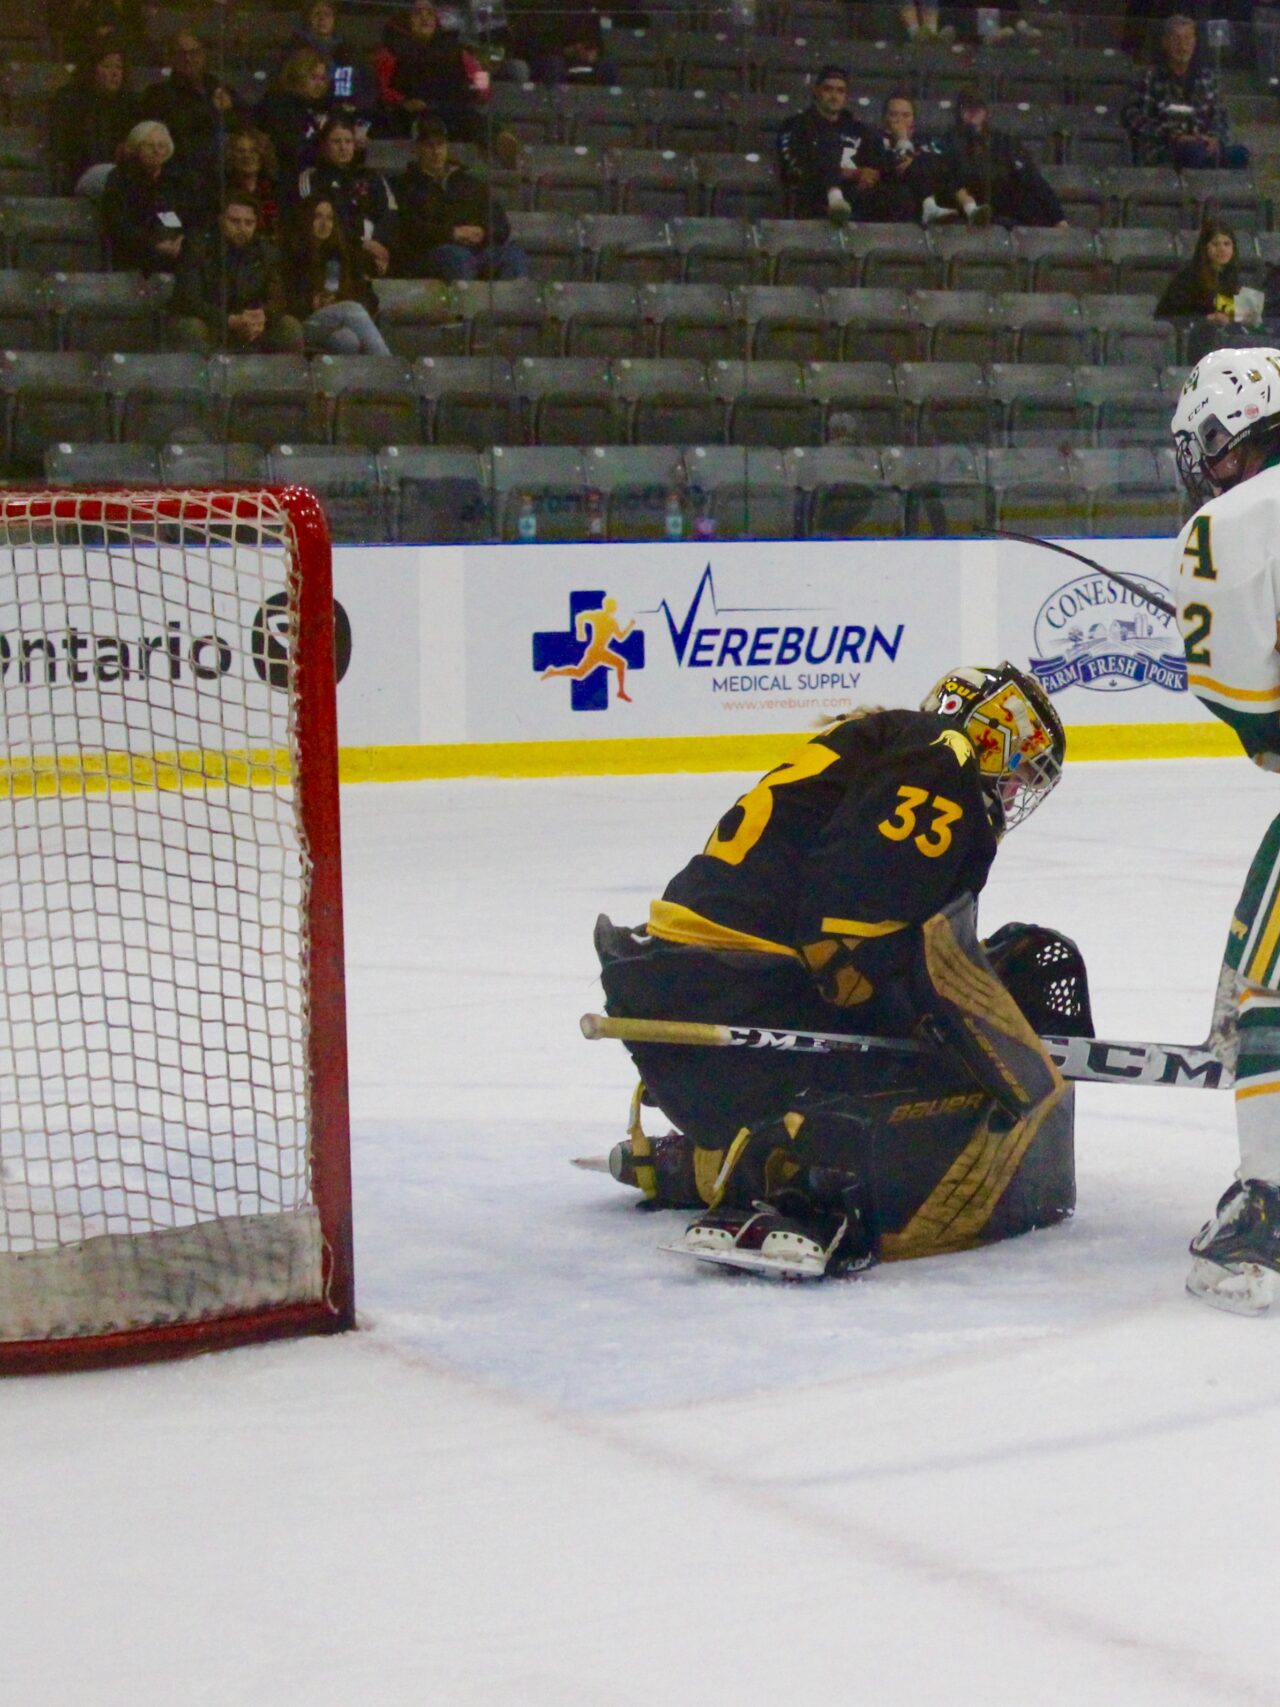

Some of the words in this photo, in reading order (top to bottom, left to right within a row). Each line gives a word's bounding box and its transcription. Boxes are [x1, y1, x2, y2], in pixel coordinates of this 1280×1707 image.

[1187, 397, 1210, 423] CCM
[1180, 514, 1218, 582] A
[659, 570, 906, 667] VEREBURN
[712, 674, 793, 693] MEDICAL
[797, 672, 861, 690] SUPPLY
[1041, 666, 1077, 694] FARM
[1088, 656, 1137, 679] FRESH
[1149, 664, 1185, 689] PORK
[720, 696, 853, 713] www.vereburn.com
[878, 785, 963, 858] 33
